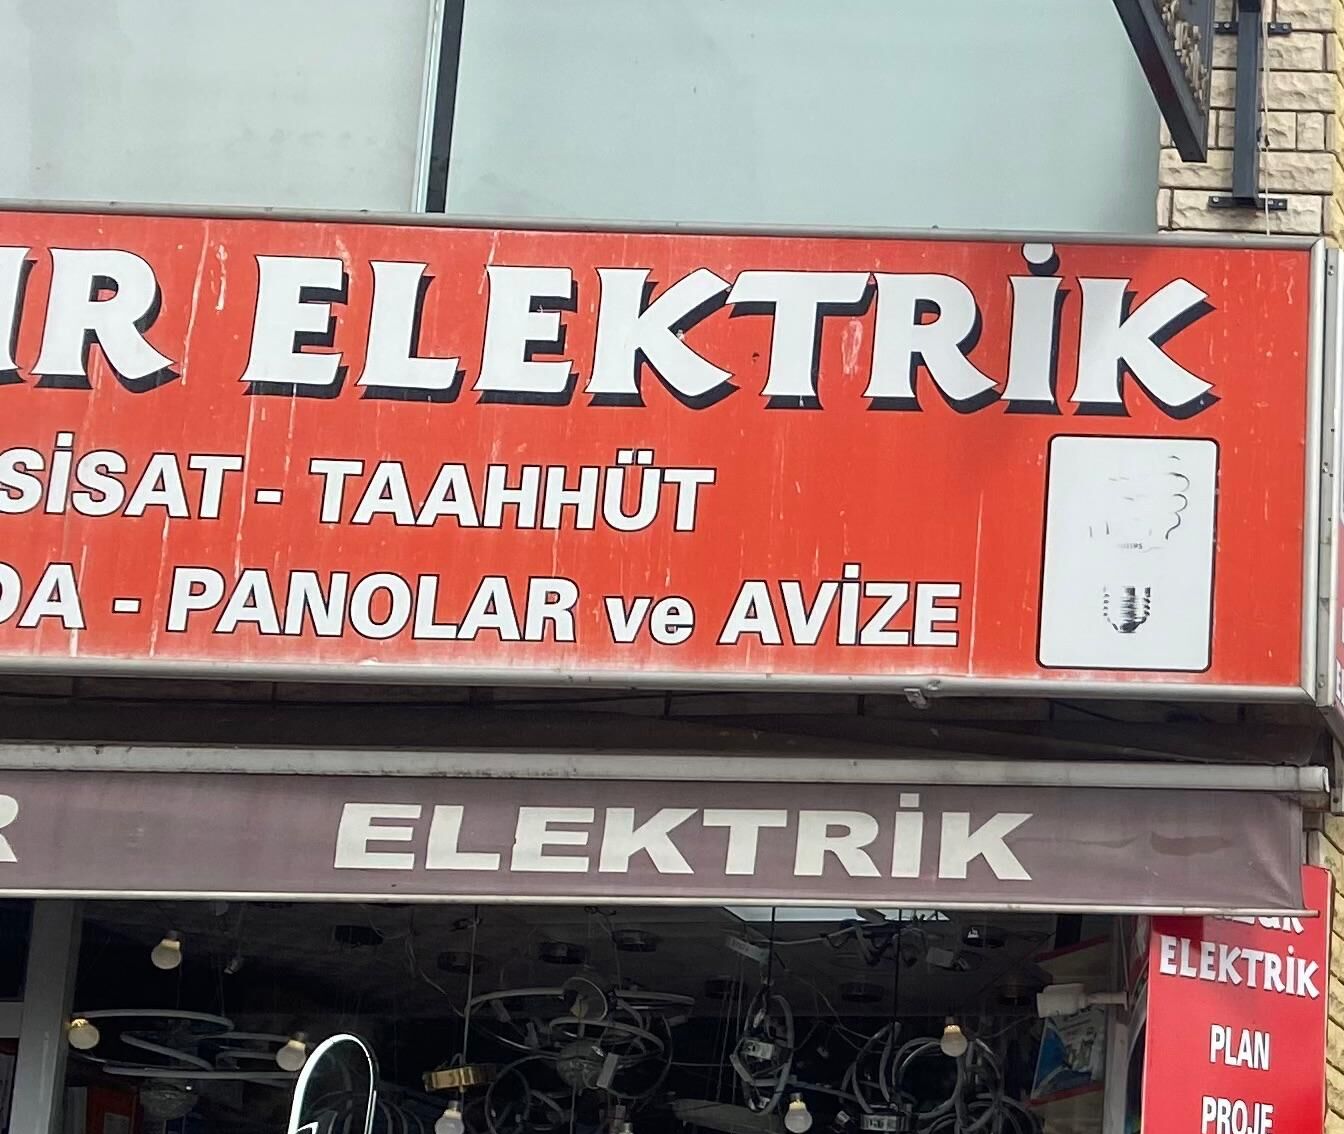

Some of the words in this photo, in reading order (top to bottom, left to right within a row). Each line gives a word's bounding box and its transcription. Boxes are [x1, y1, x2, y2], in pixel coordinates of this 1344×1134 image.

[241, 243, 1219, 419] ELEKTRİK
[309, 449, 717, 532] TAAHHÜT
[166, 567, 580, 642] PANOLAR
[605, 596, 695, 644] ve
[716, 562, 961, 647] AVİZE
[333, 793, 1033, 881] ELEKTRİK
[1160, 934, 1320, 1000] ELEKTRİK
[1209, 1024, 1270, 1071] PLAN
